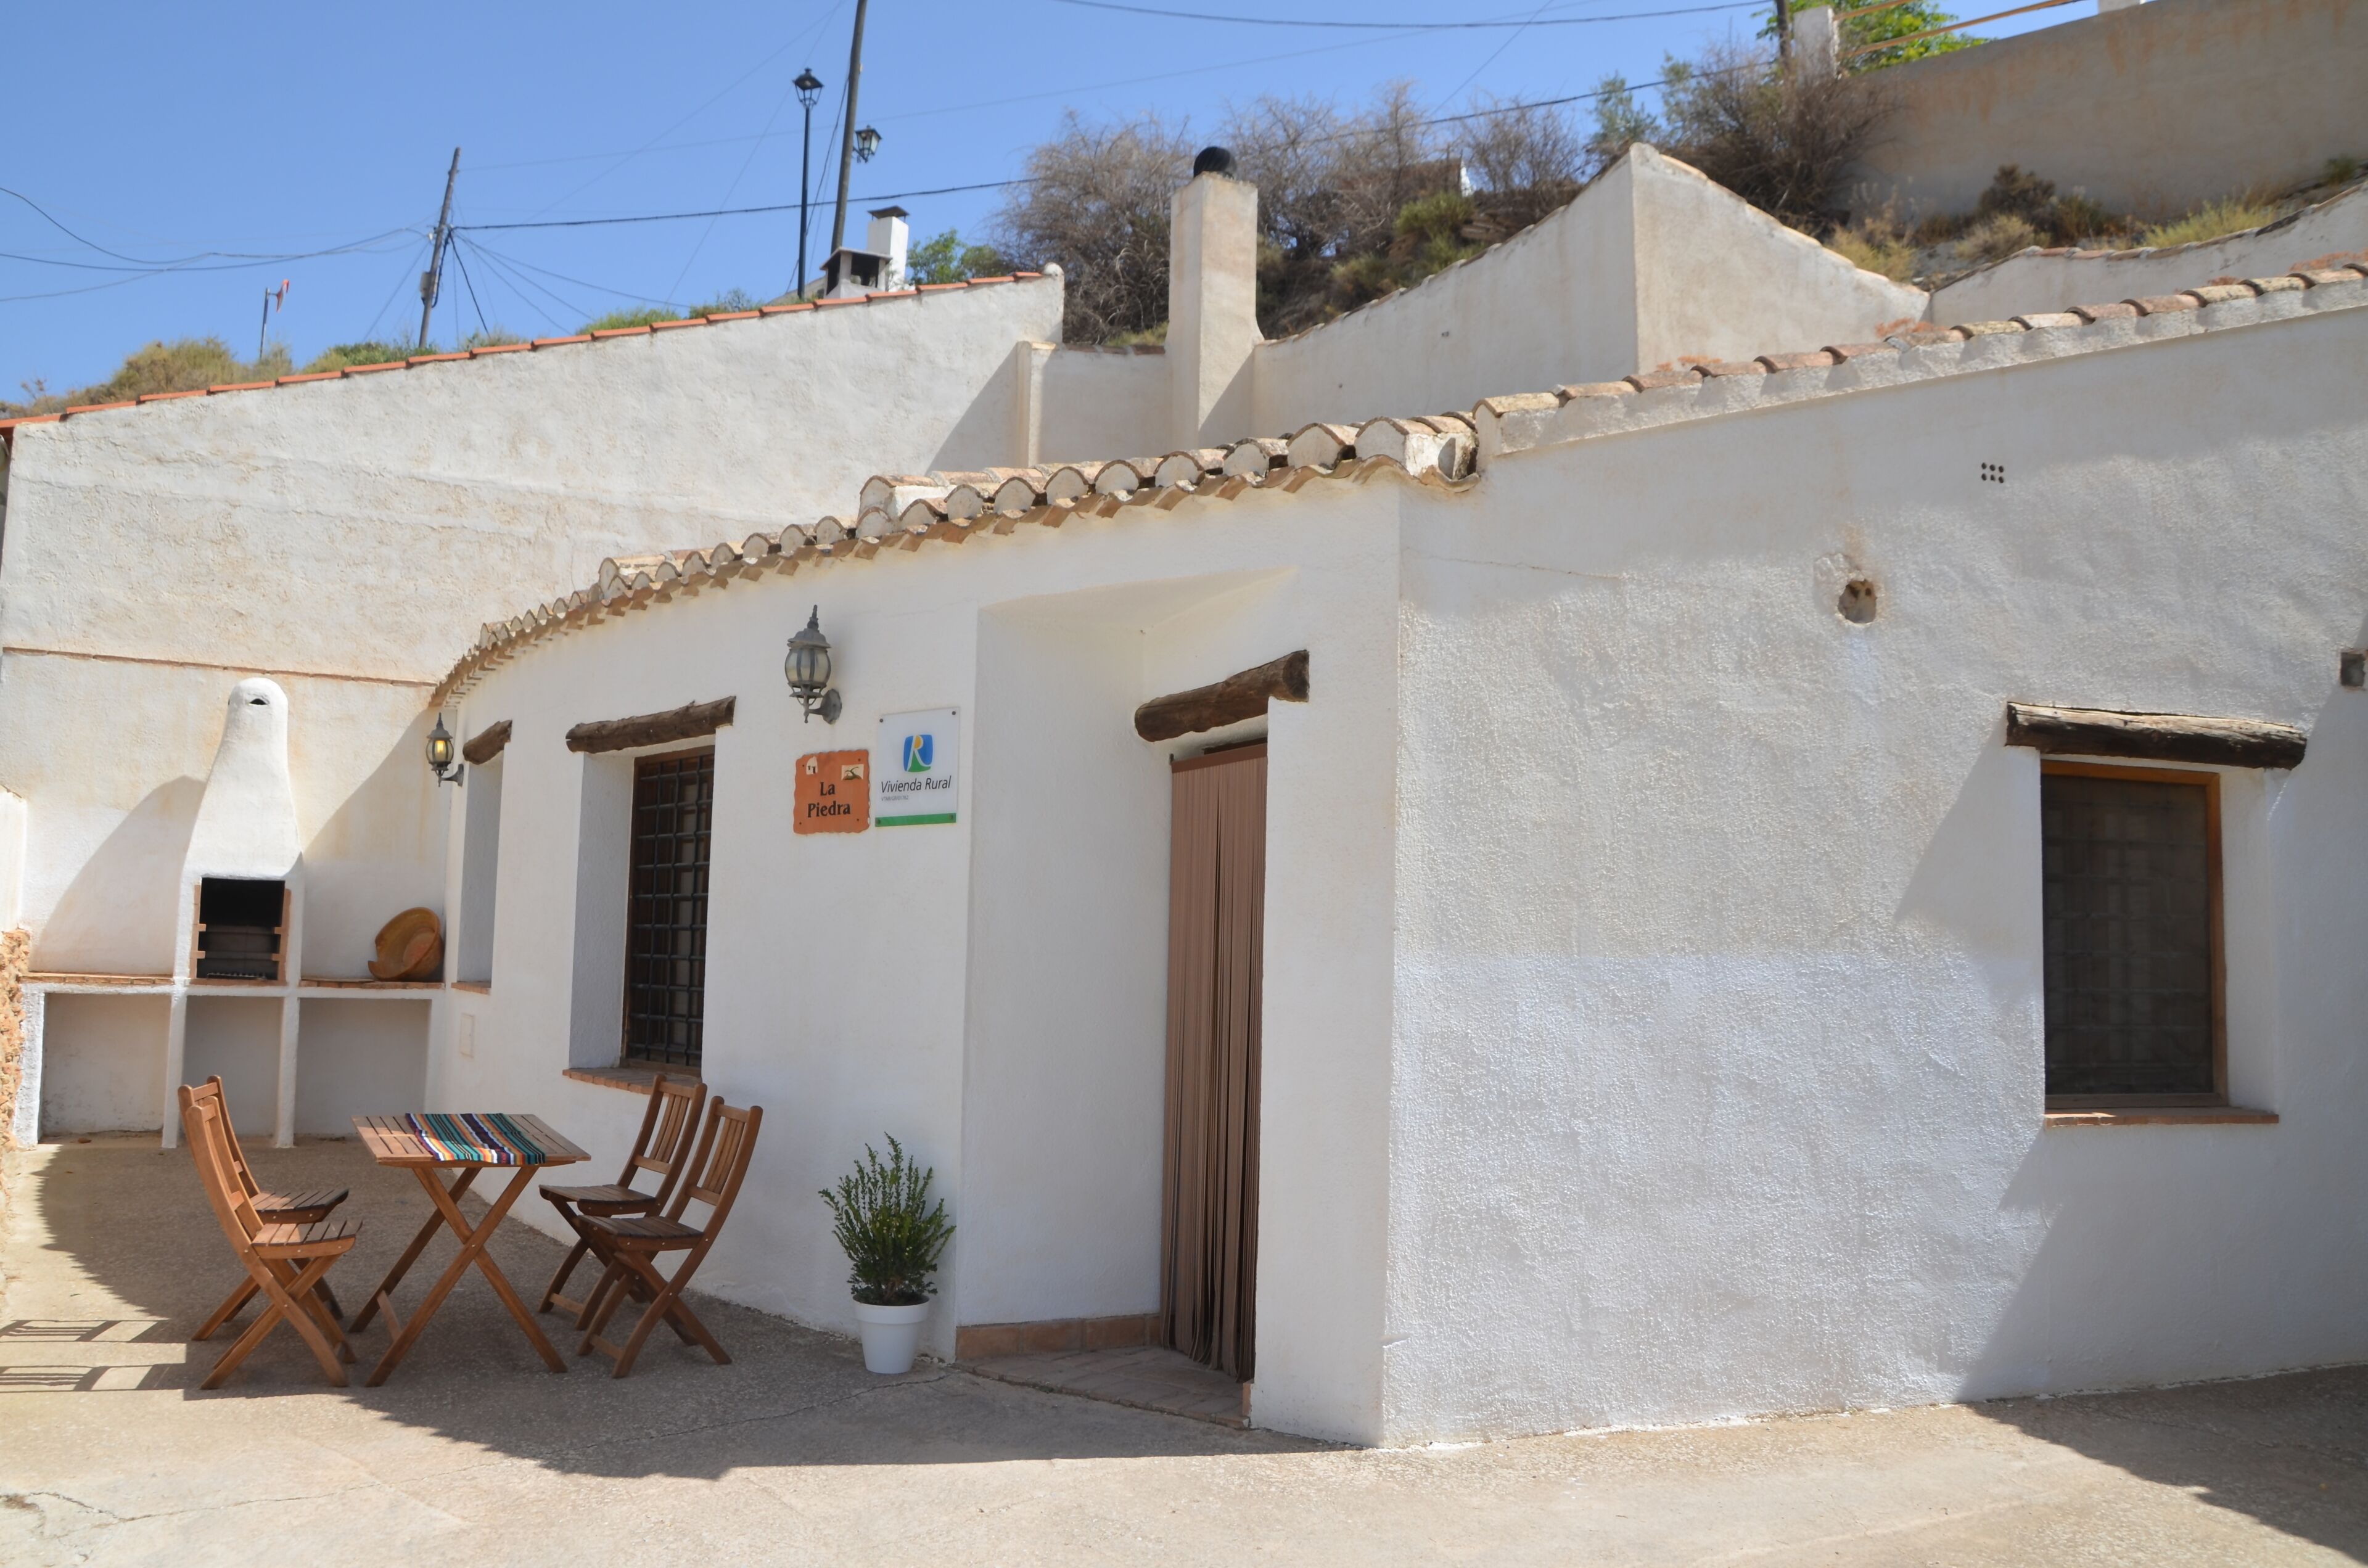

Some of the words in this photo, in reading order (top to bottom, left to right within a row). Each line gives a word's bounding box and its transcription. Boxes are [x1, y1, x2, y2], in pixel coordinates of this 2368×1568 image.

[820, 781, 835, 796] La
[881, 778, 922, 793] Vivienda
[925, 775, 952, 789] Rural
[807, 800, 850, 818] Piedra
